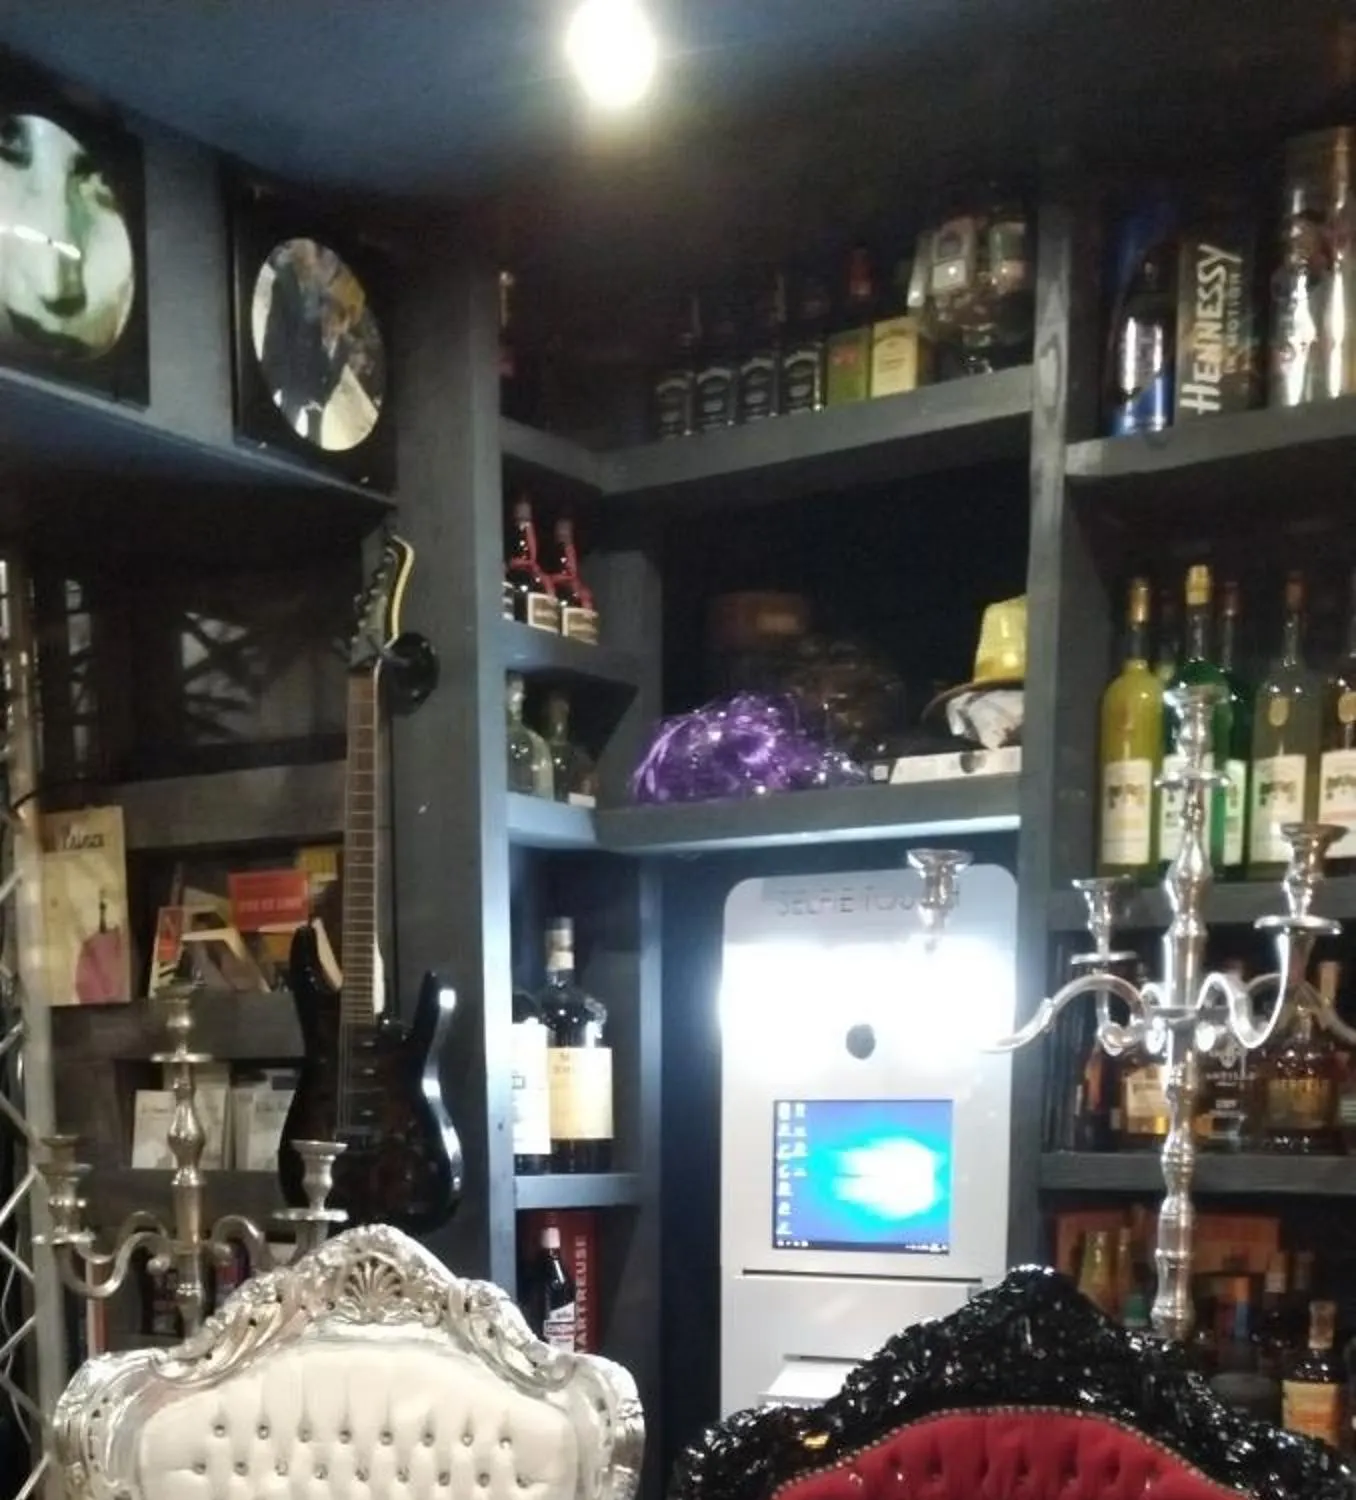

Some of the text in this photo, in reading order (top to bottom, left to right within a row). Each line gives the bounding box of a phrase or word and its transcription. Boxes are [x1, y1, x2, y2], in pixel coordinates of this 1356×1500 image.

[1179, 243, 1244, 415] HENNESSY
[863, 884, 961, 912] TOUH
[574, 1234, 588, 1353] ARTREUSE
